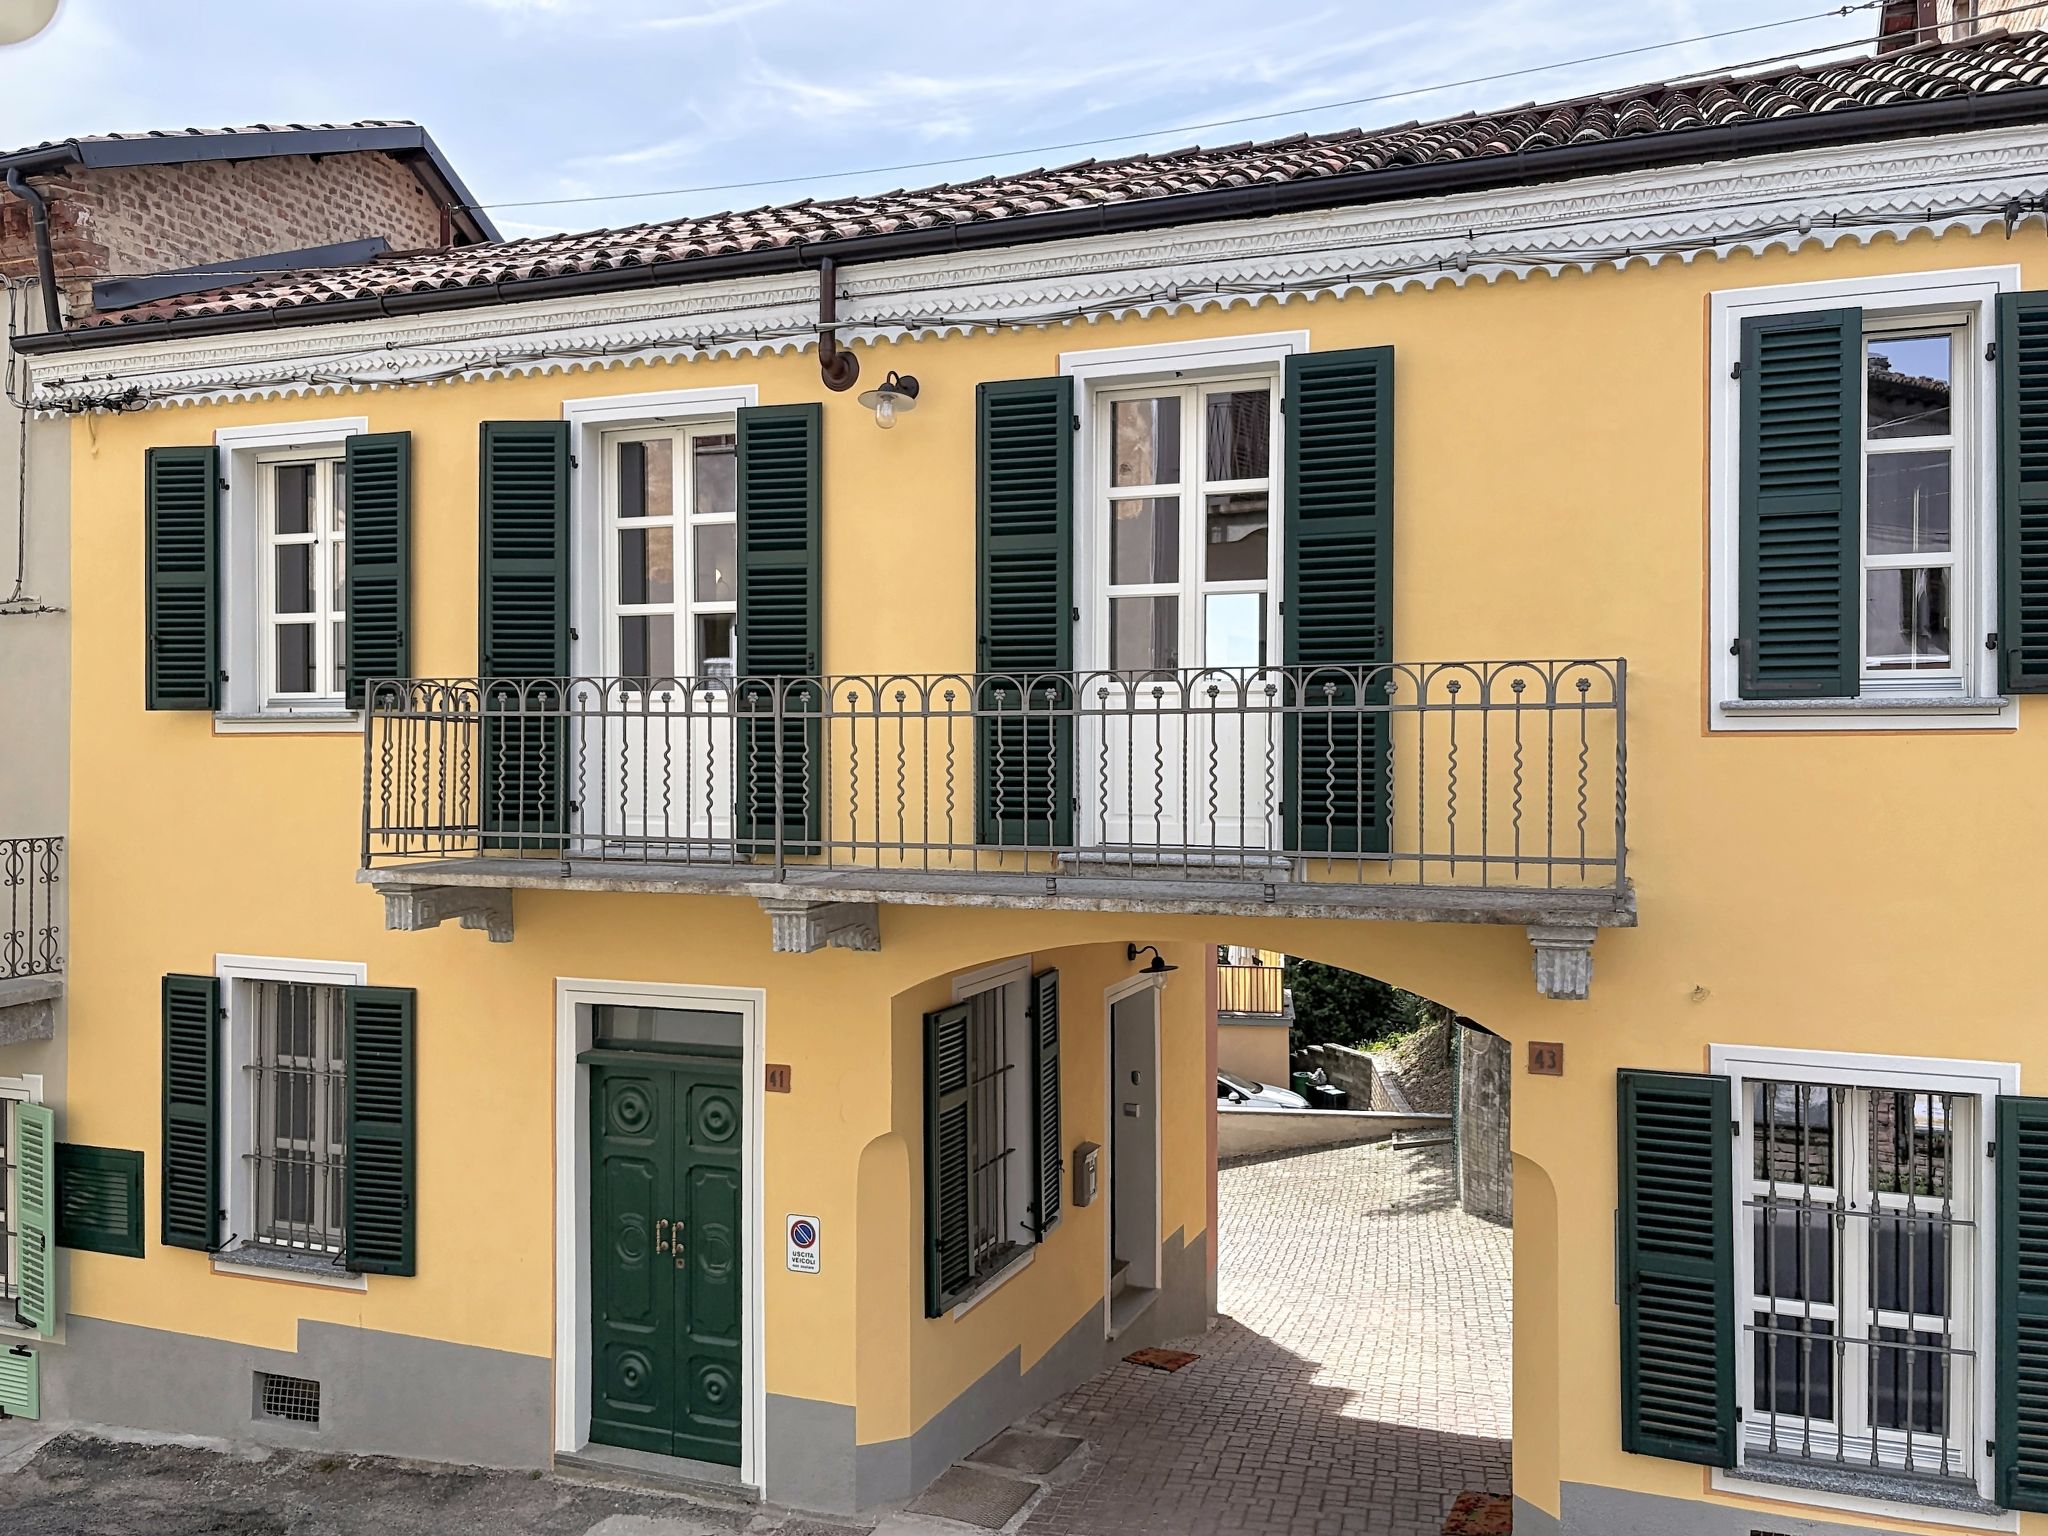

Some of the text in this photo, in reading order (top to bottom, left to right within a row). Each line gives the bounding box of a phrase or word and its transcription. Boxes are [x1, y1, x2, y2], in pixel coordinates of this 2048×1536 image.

[1535, 1049, 1556, 1069] 43
[769, 1070, 784, 1087] 41
[792, 1257, 815, 1265] VEICOLI
